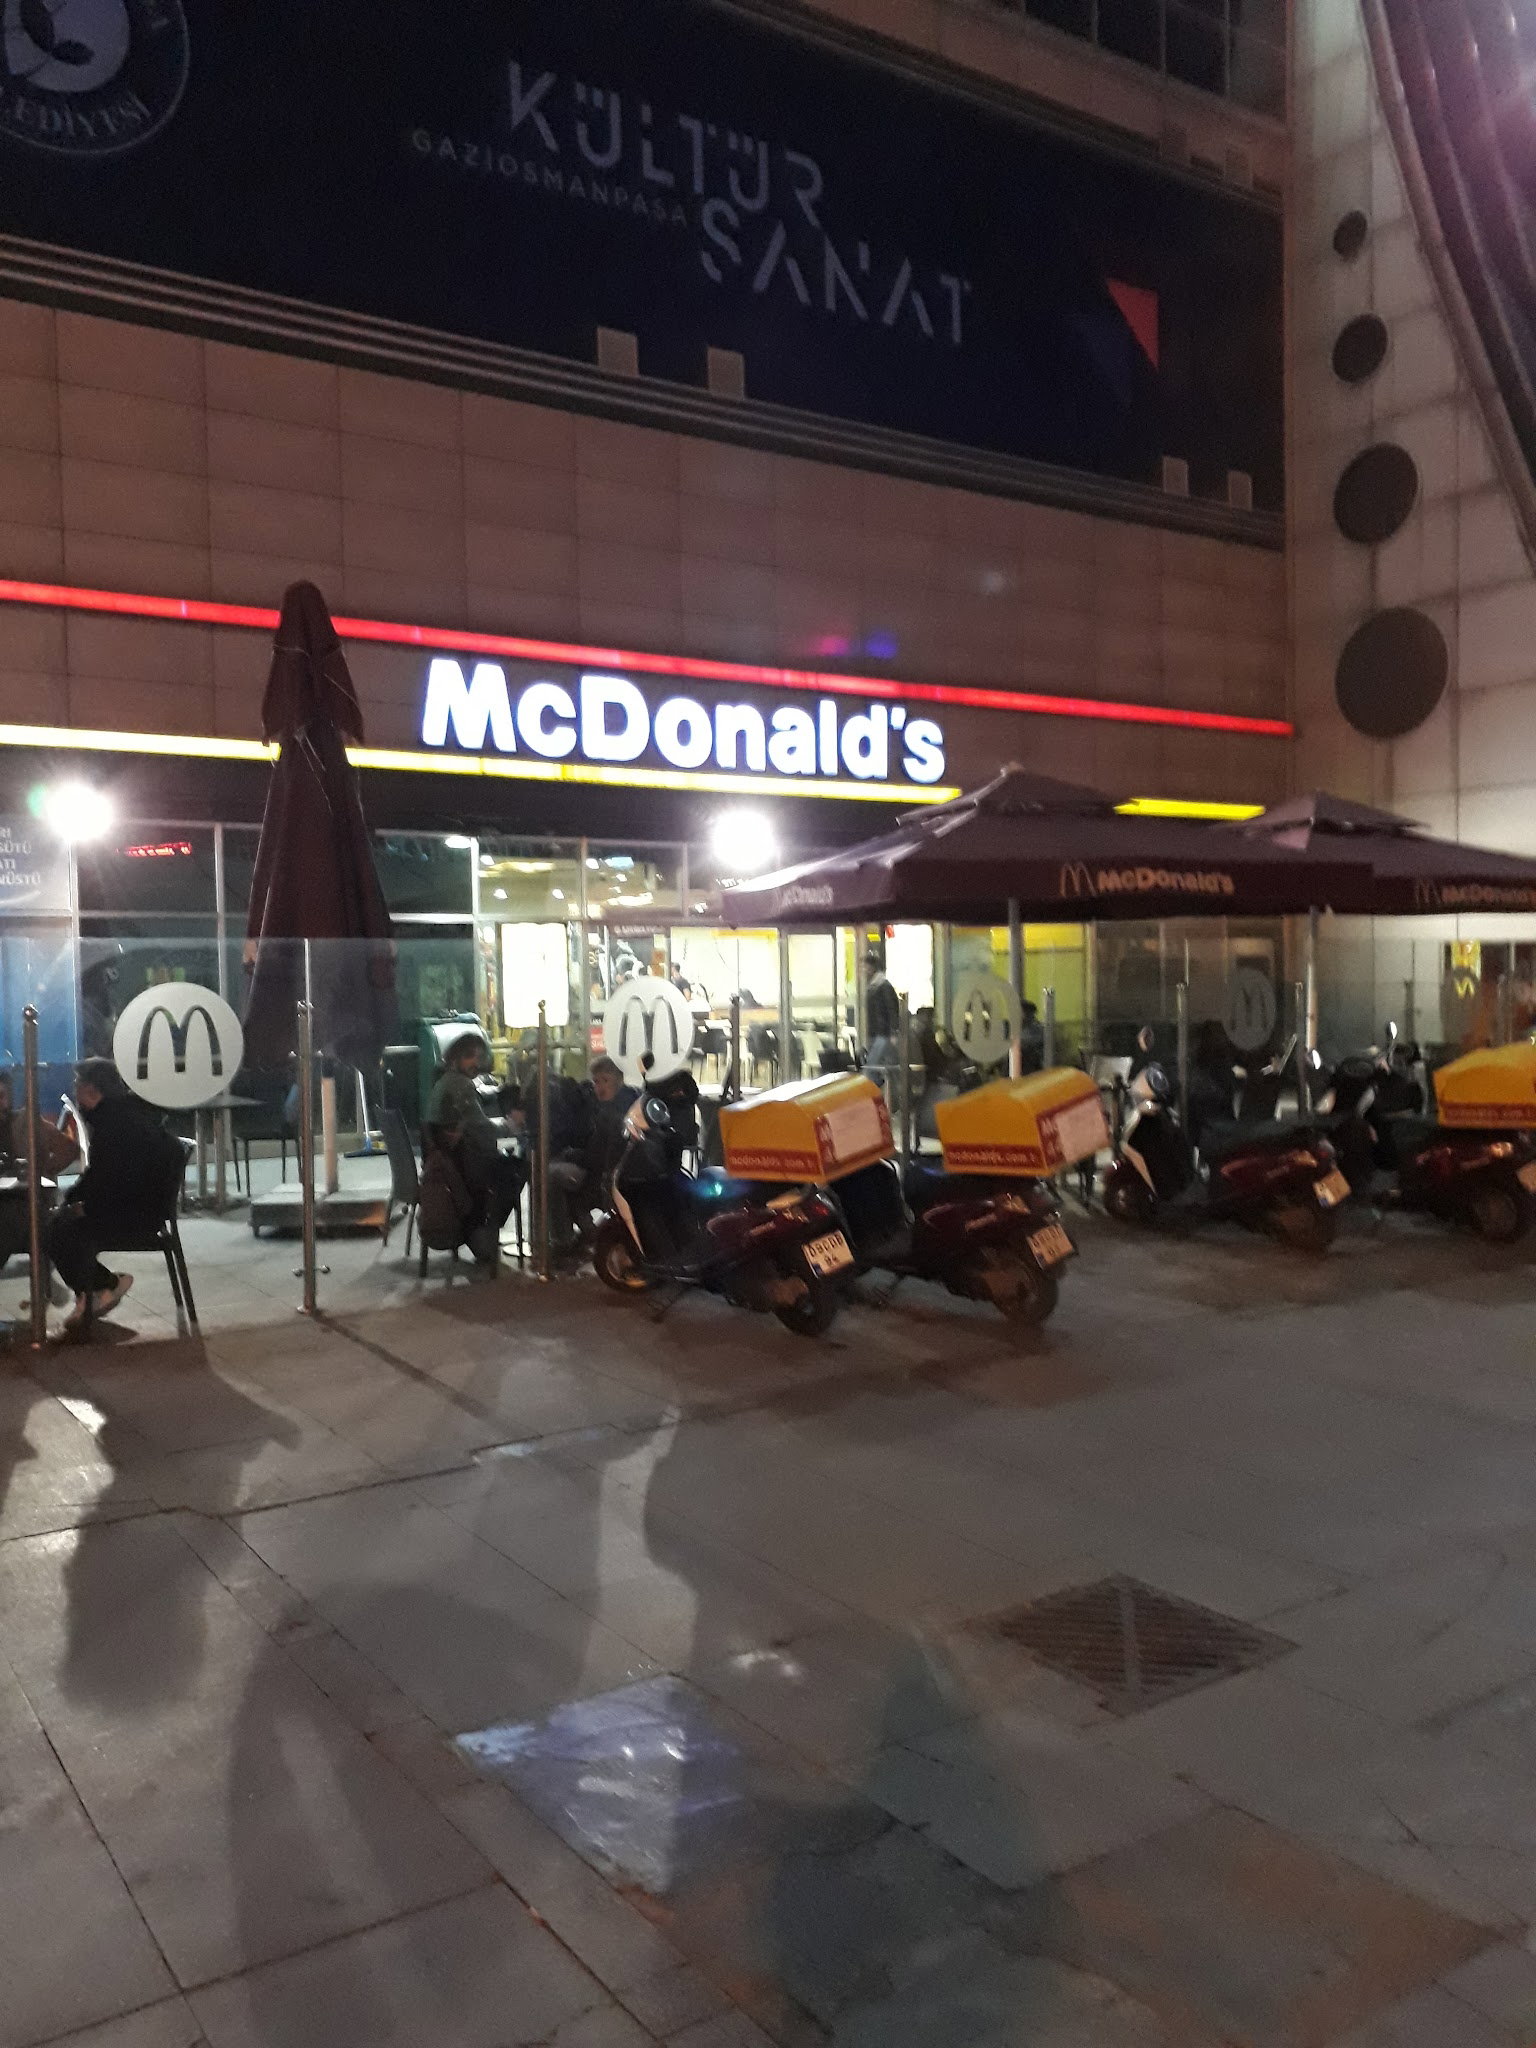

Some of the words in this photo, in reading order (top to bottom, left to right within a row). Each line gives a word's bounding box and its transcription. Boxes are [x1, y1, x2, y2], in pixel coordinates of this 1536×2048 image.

[508, 60, 824, 229] KÜLTÜR
[701, 198, 972, 346] SANAT
[422, 658, 946, 783] McDonald's
[1097, 867, 1235, 895] McDonald's
